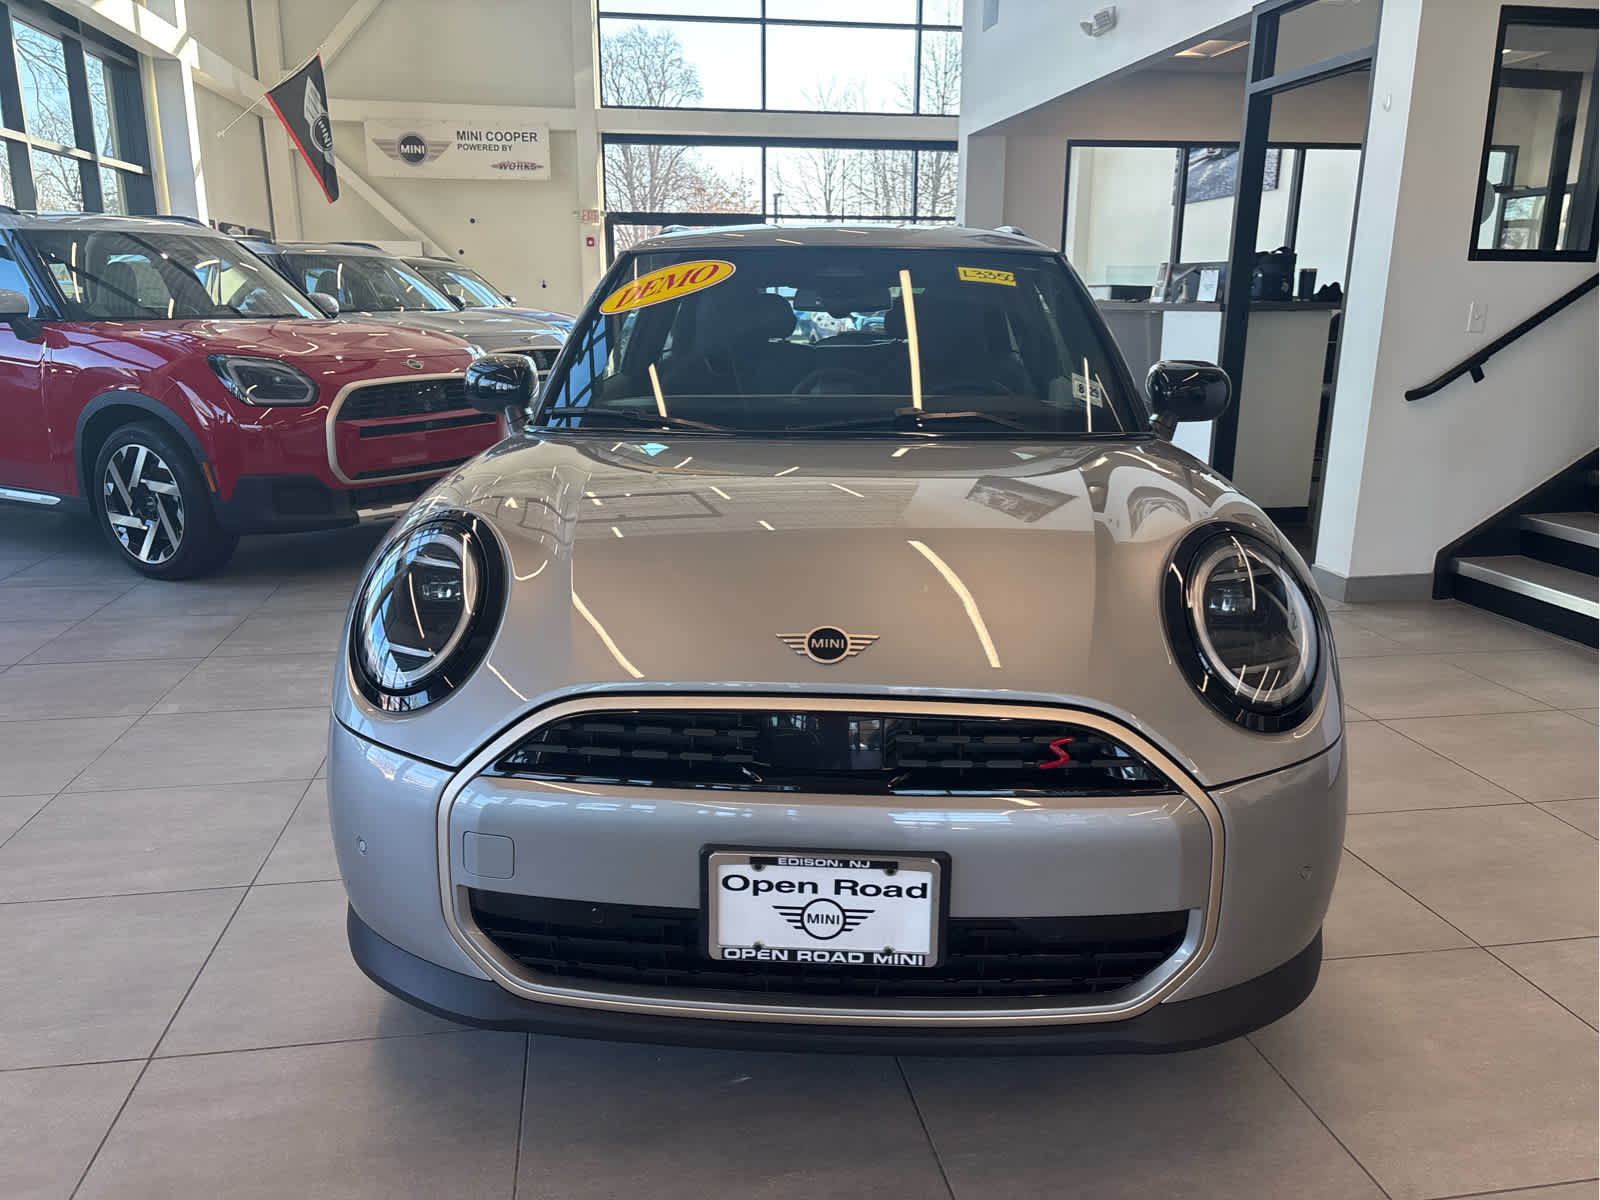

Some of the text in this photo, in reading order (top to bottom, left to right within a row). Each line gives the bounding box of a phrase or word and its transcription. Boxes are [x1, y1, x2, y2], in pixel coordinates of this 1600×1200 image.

[456, 130, 538, 142] MINI COOPER
[400, 144, 425, 154] MINI
[457, 143, 513, 152] POWERED BY
[614, 264, 720, 309] DEMO
[810, 638, 845, 649] MINI
[1038, 736, 1074, 770] S
[849, 860, 871, 869] NJ
[721, 874, 929, 899] Open Road
[806, 912, 841, 926] MINI
[723, 948, 924, 966] OPEN ROAD MINI
